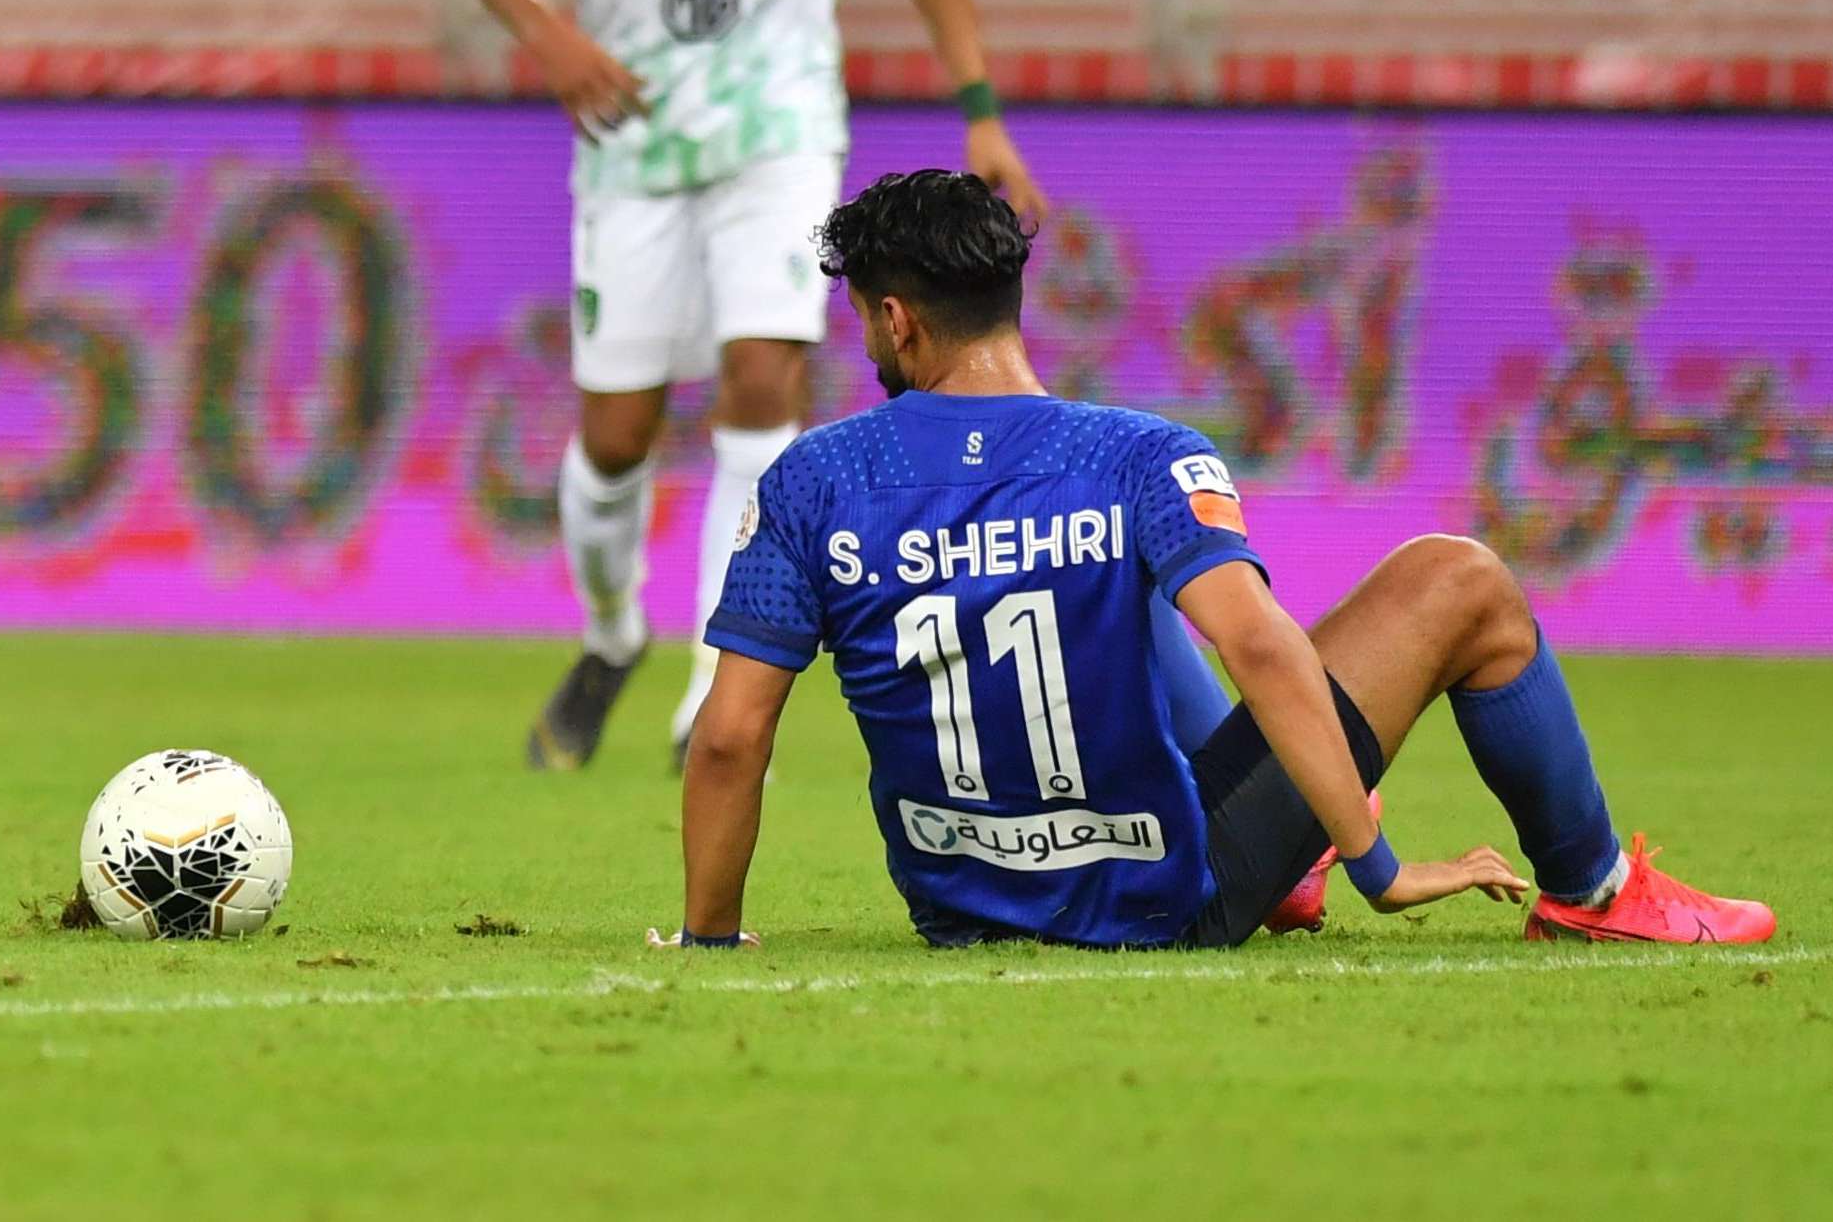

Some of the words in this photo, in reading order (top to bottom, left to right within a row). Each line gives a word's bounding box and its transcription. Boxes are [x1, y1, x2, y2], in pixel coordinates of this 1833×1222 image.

[828, 530, 880, 585] S.
[896, 504, 1124, 584] SHEHRI
[893, 589, 1087, 801] 11
[957, 817, 1151, 863] التعاونية
